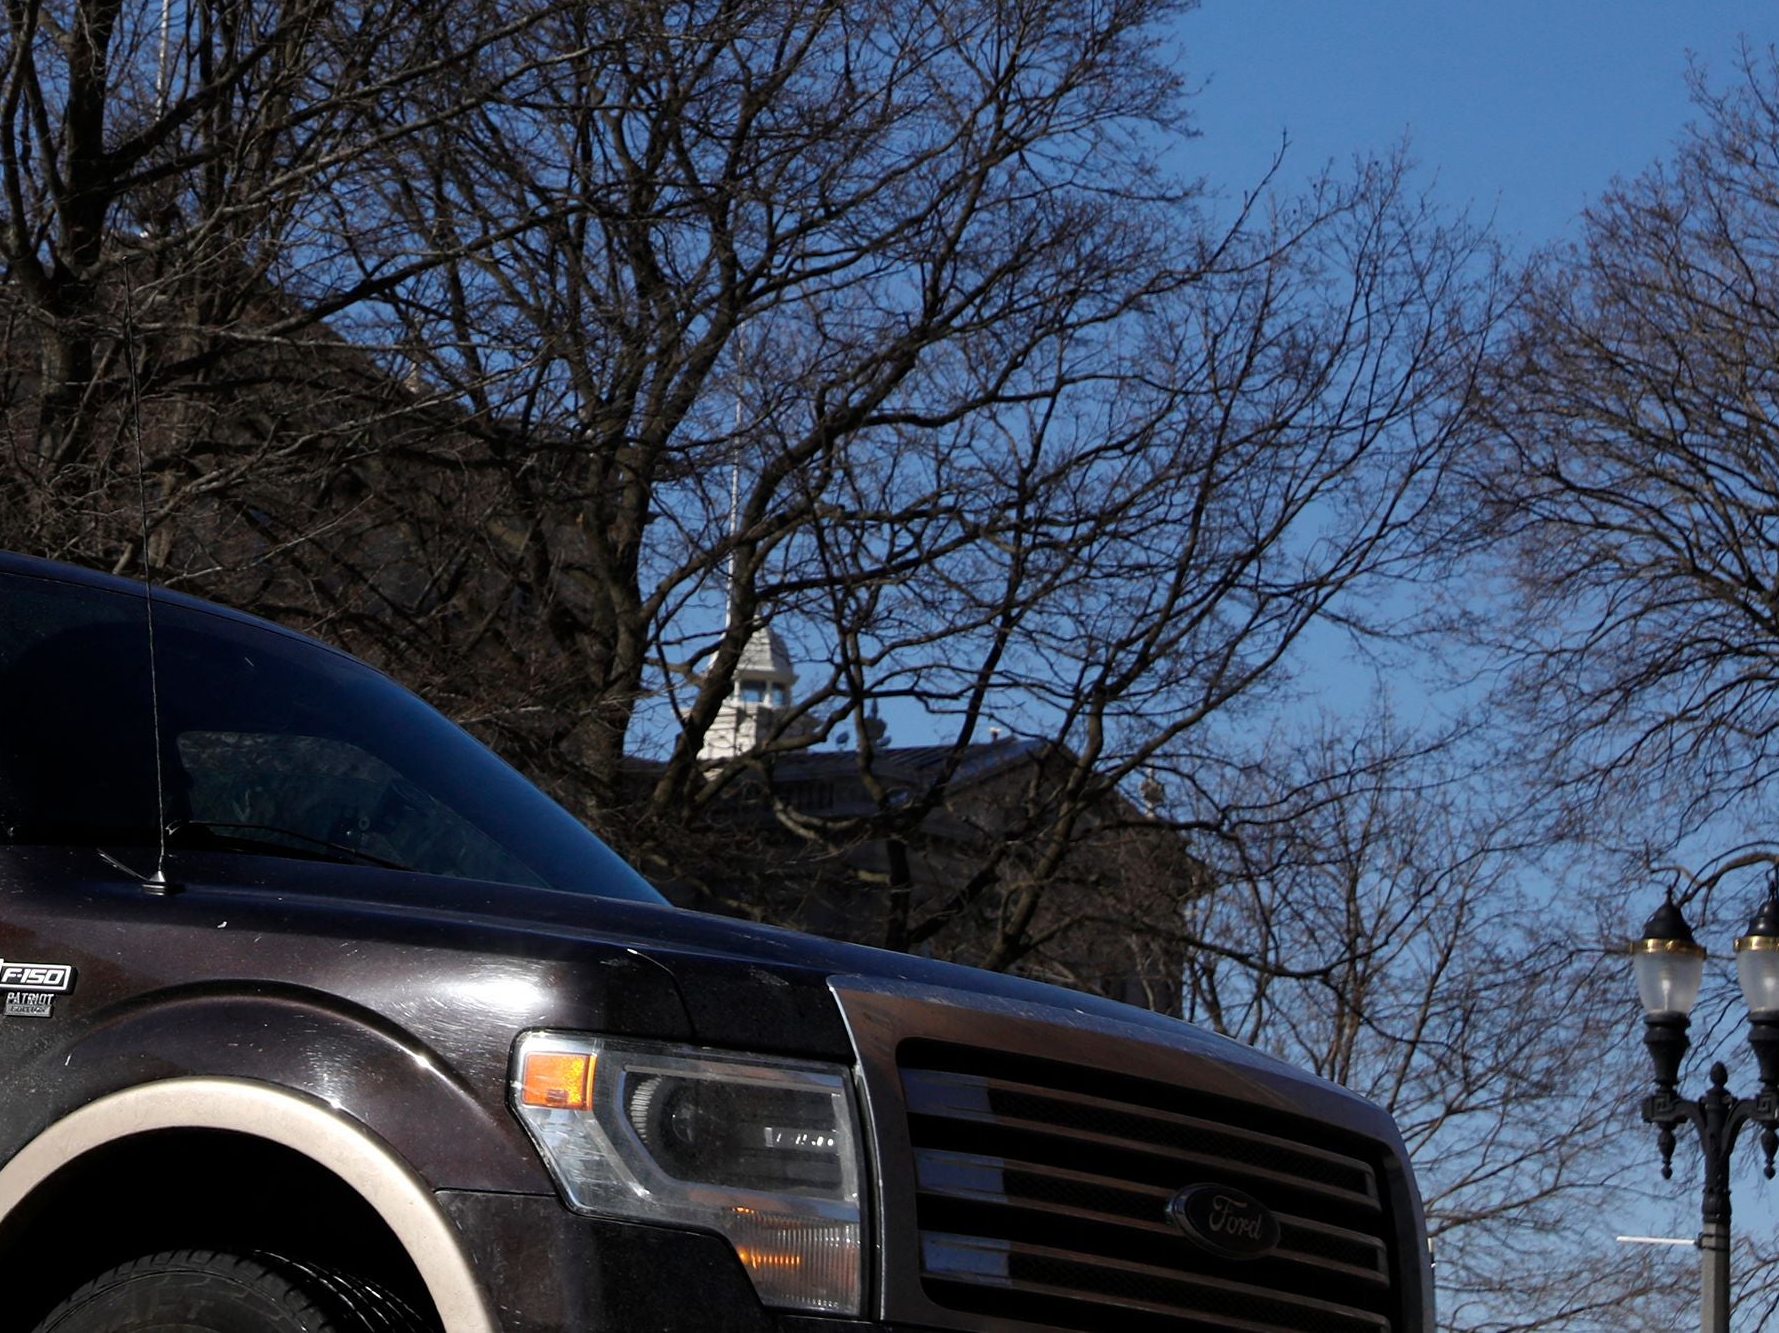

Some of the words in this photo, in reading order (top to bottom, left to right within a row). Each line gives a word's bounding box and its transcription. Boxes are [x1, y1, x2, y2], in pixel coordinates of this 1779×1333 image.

[1, 968, 65, 985] F-150
[6, 992, 55, 1005] PATRIOT
[1209, 1195, 1262, 1239] Ford
